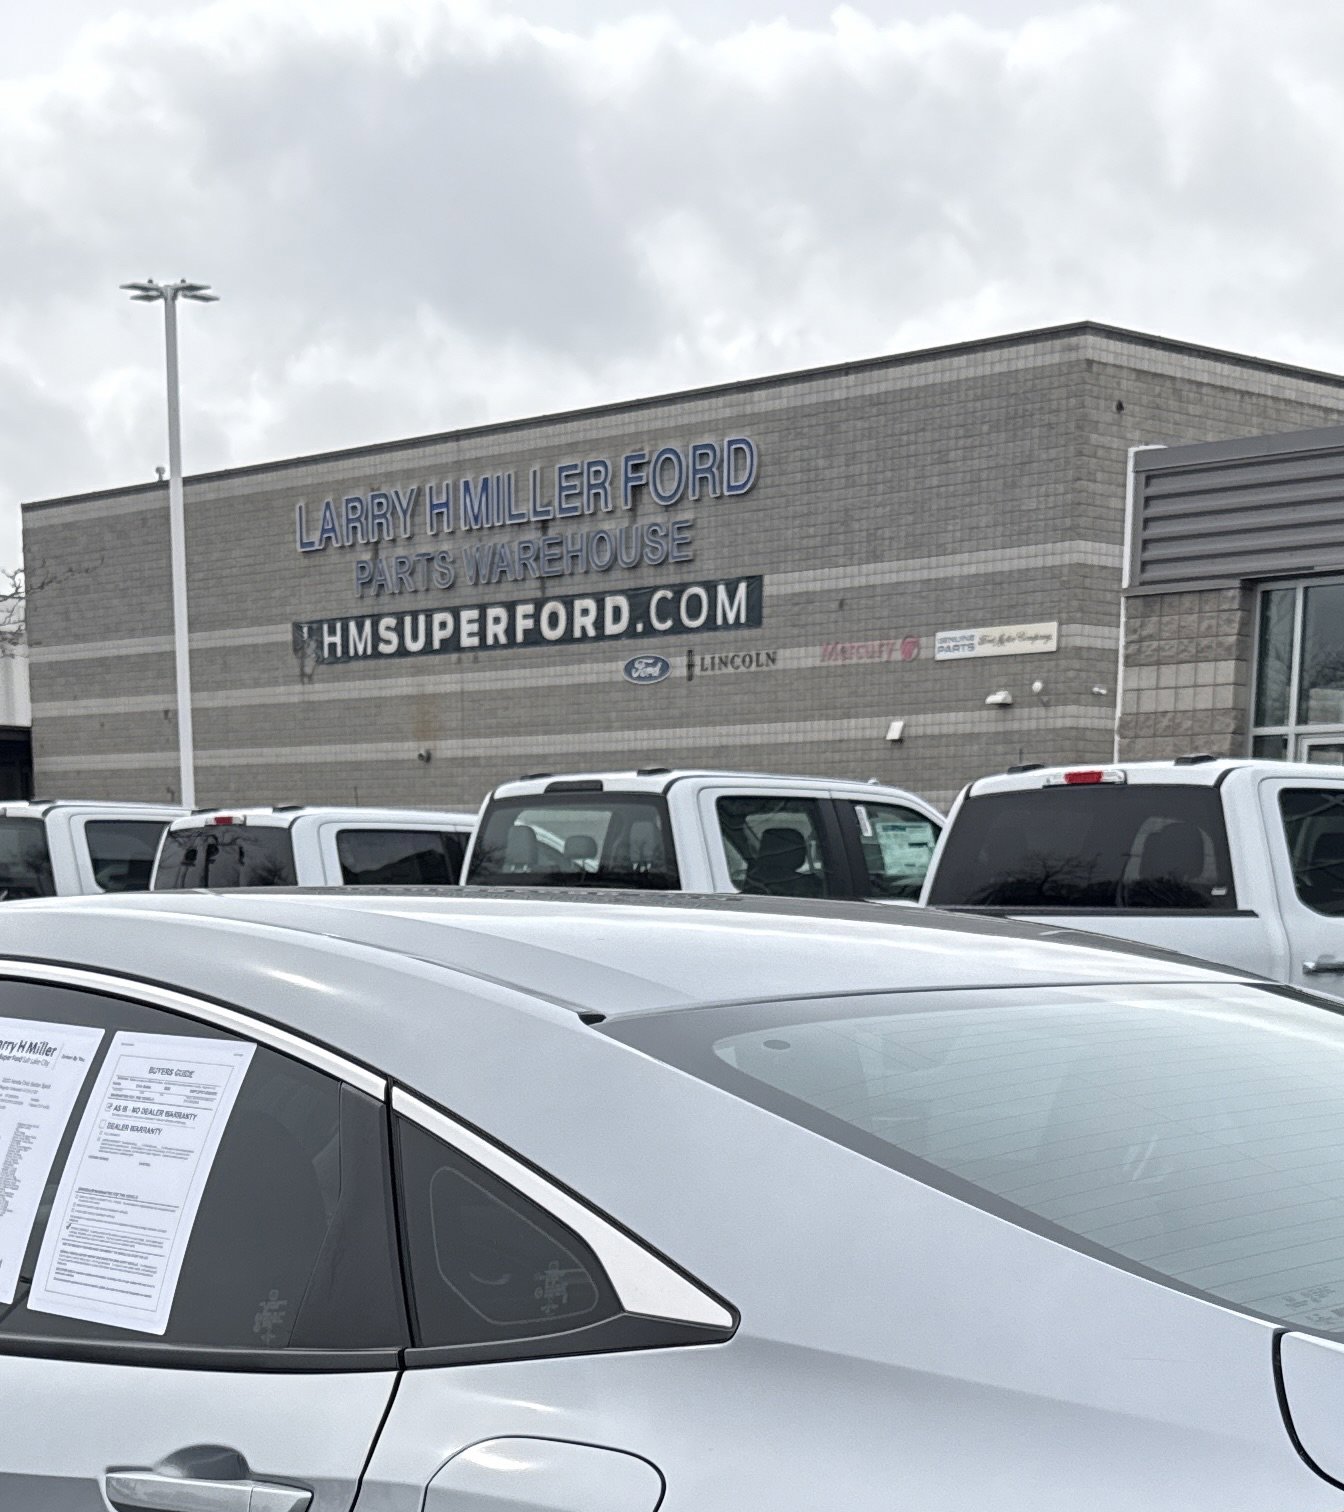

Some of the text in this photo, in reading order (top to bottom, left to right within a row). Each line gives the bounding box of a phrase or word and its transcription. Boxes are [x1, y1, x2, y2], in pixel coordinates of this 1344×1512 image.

[296, 437, 757, 552] LARRY H MILLER FORD
[356, 519, 694, 598] PARTS WAREHOUSE
[302, 582, 747, 658] HMSUPERFORD.COM
[629, 657, 664, 679] Ford
[699, 651, 778, 672] LINCOLN
[17, 1040, 28, 1053] H
[27, 1040, 57, 1057] Miller
